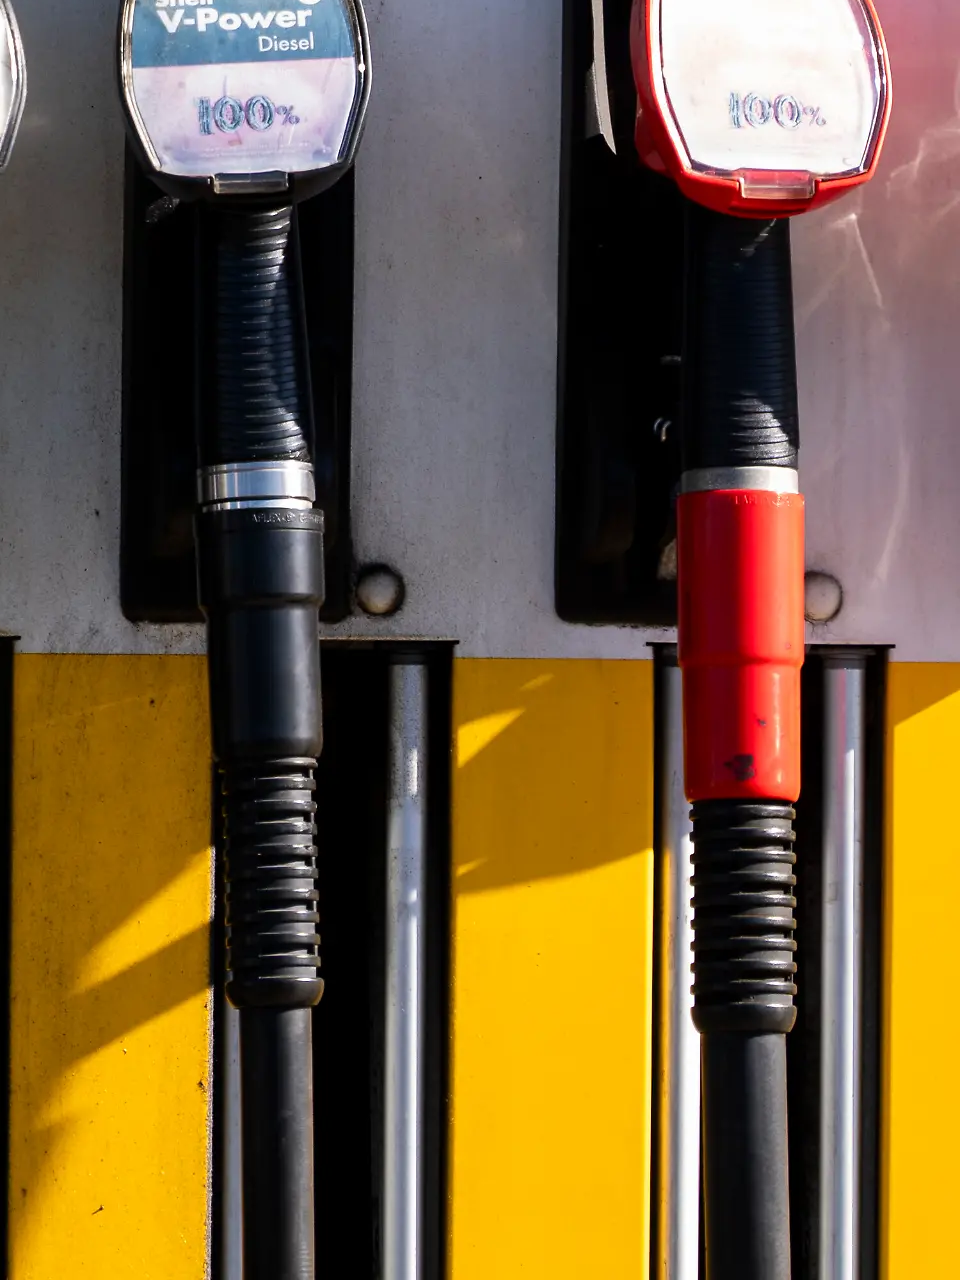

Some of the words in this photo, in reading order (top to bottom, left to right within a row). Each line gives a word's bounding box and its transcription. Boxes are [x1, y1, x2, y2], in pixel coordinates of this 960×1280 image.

[155, 8, 313, 34] V-Power
[258, 32, 315, 53] Diesel
[196, 94, 300, 136] 100%
